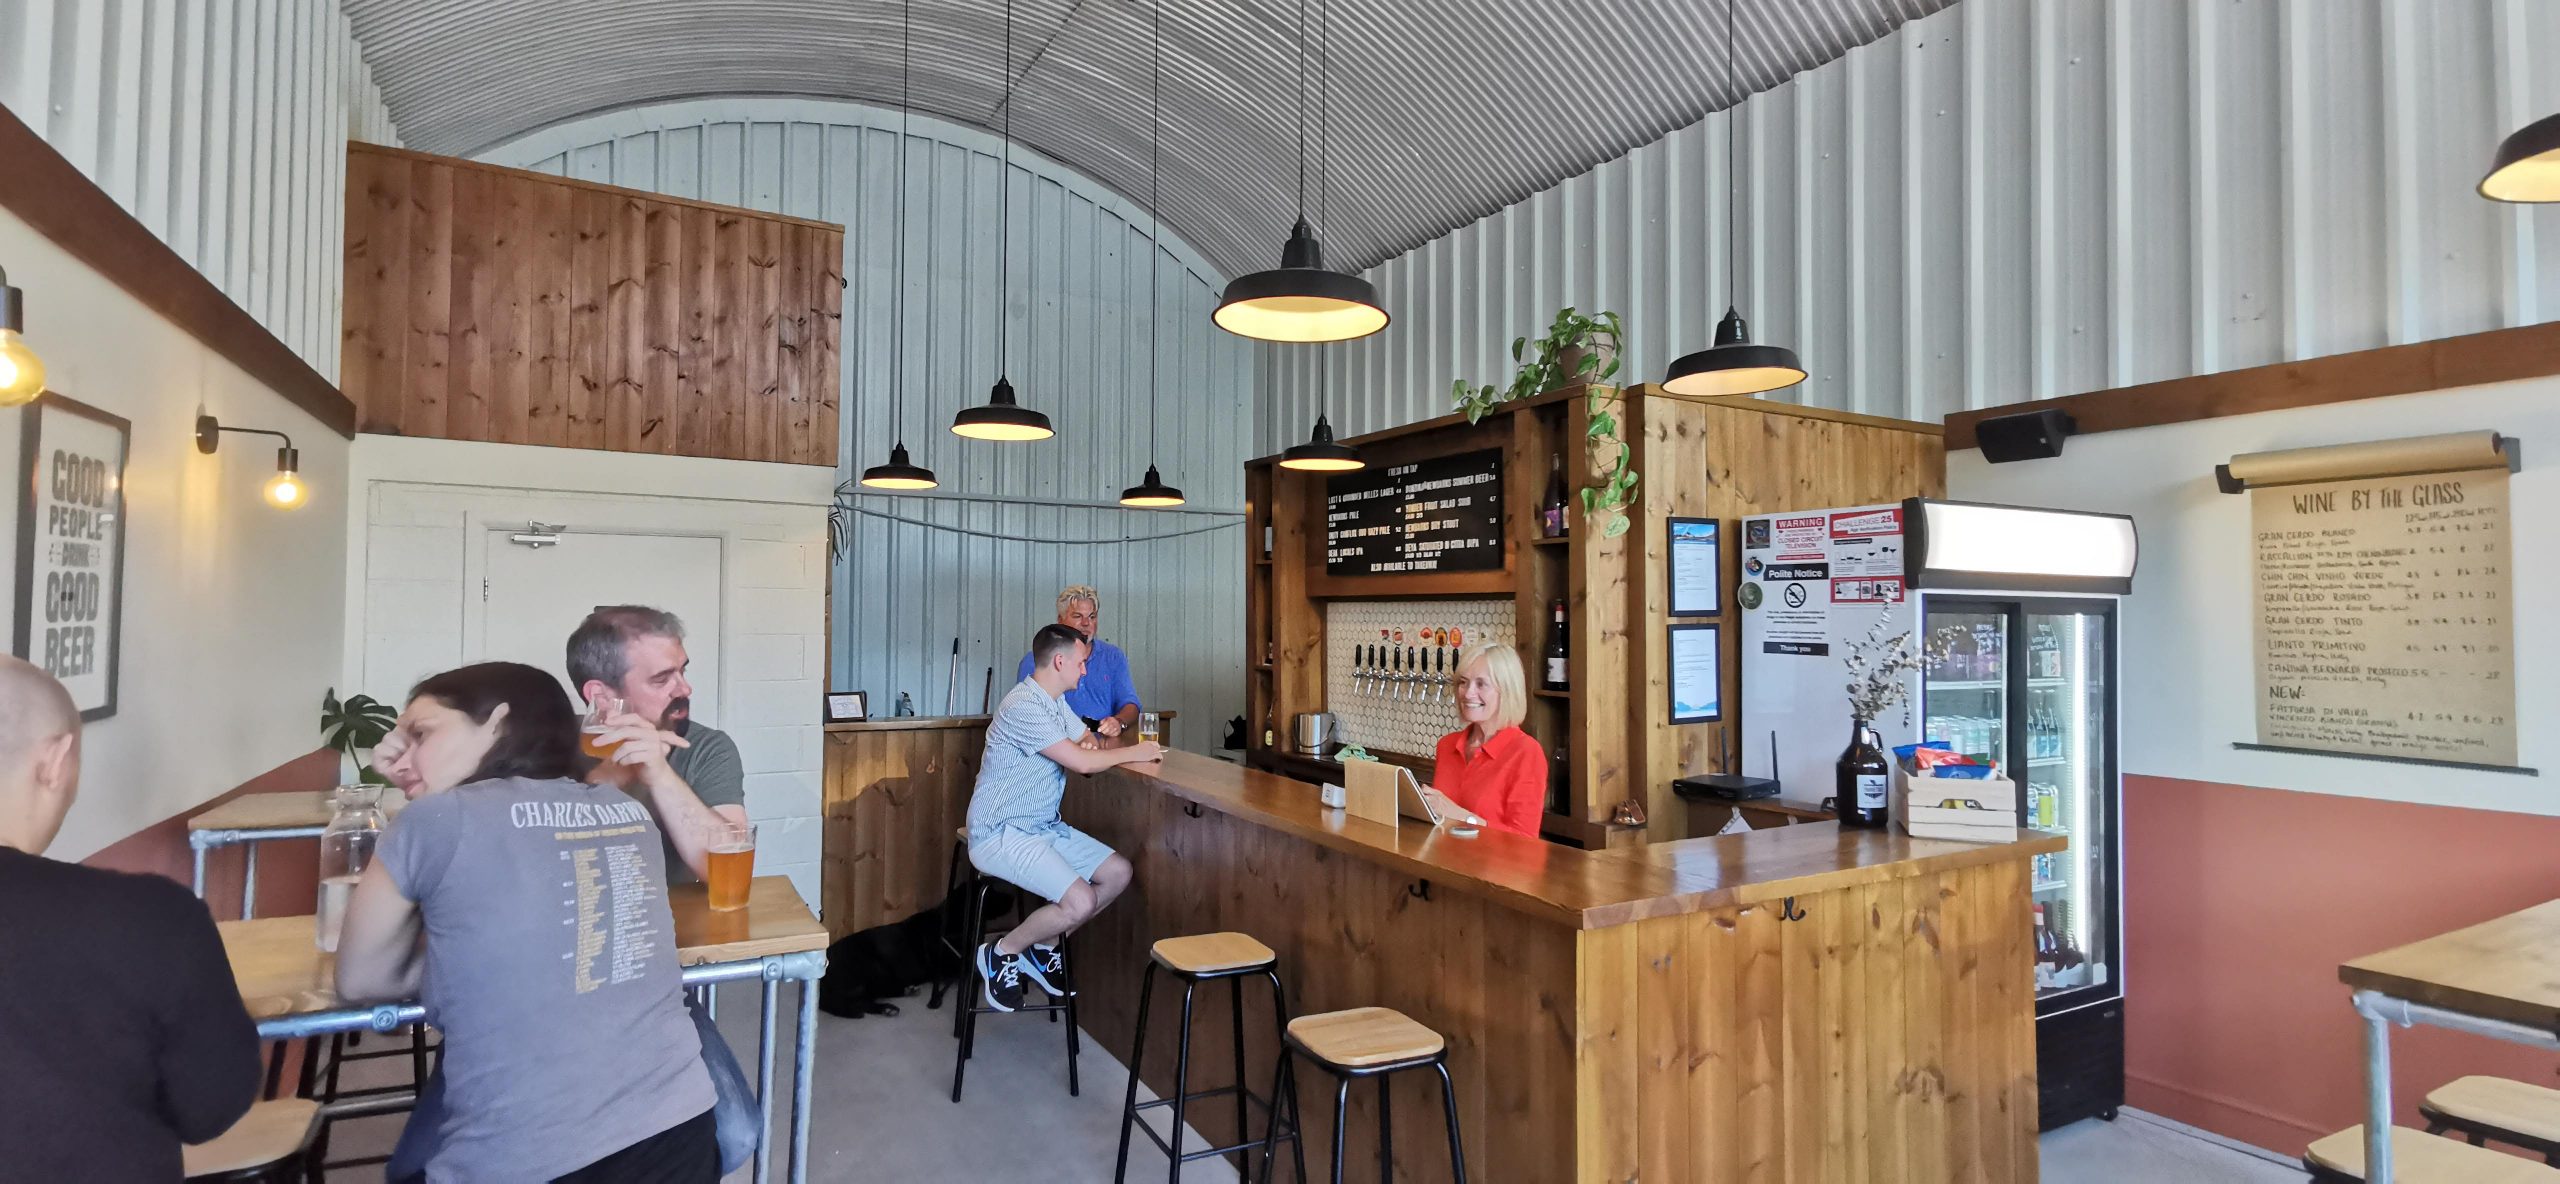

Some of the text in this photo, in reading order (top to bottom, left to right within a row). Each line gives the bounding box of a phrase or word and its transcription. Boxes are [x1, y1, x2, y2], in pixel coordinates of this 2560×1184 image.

[52, 449, 105, 508] GOOD
[2293, 482, 2464, 514] WINE BY THE GLASS
[49, 505, 103, 541] PEOPLE
[1778, 518, 1823, 528] WARNING
[1881, 515, 1892, 523] 25
[1769, 569, 1823, 579] Polite Notice
[45, 571, 99, 623] GOOD
[2264, 592, 2289, 603] GRAN
[2294, 592, 2324, 602] CERDO
[45, 625, 95, 679] BEER
[1780, 644, 1811, 653] Thank you
[2268, 640, 2304, 651] LIANTO
[2312, 640, 2366, 652] PRIMITIVO
[510, 801, 650, 828] CHARLES DARWI
